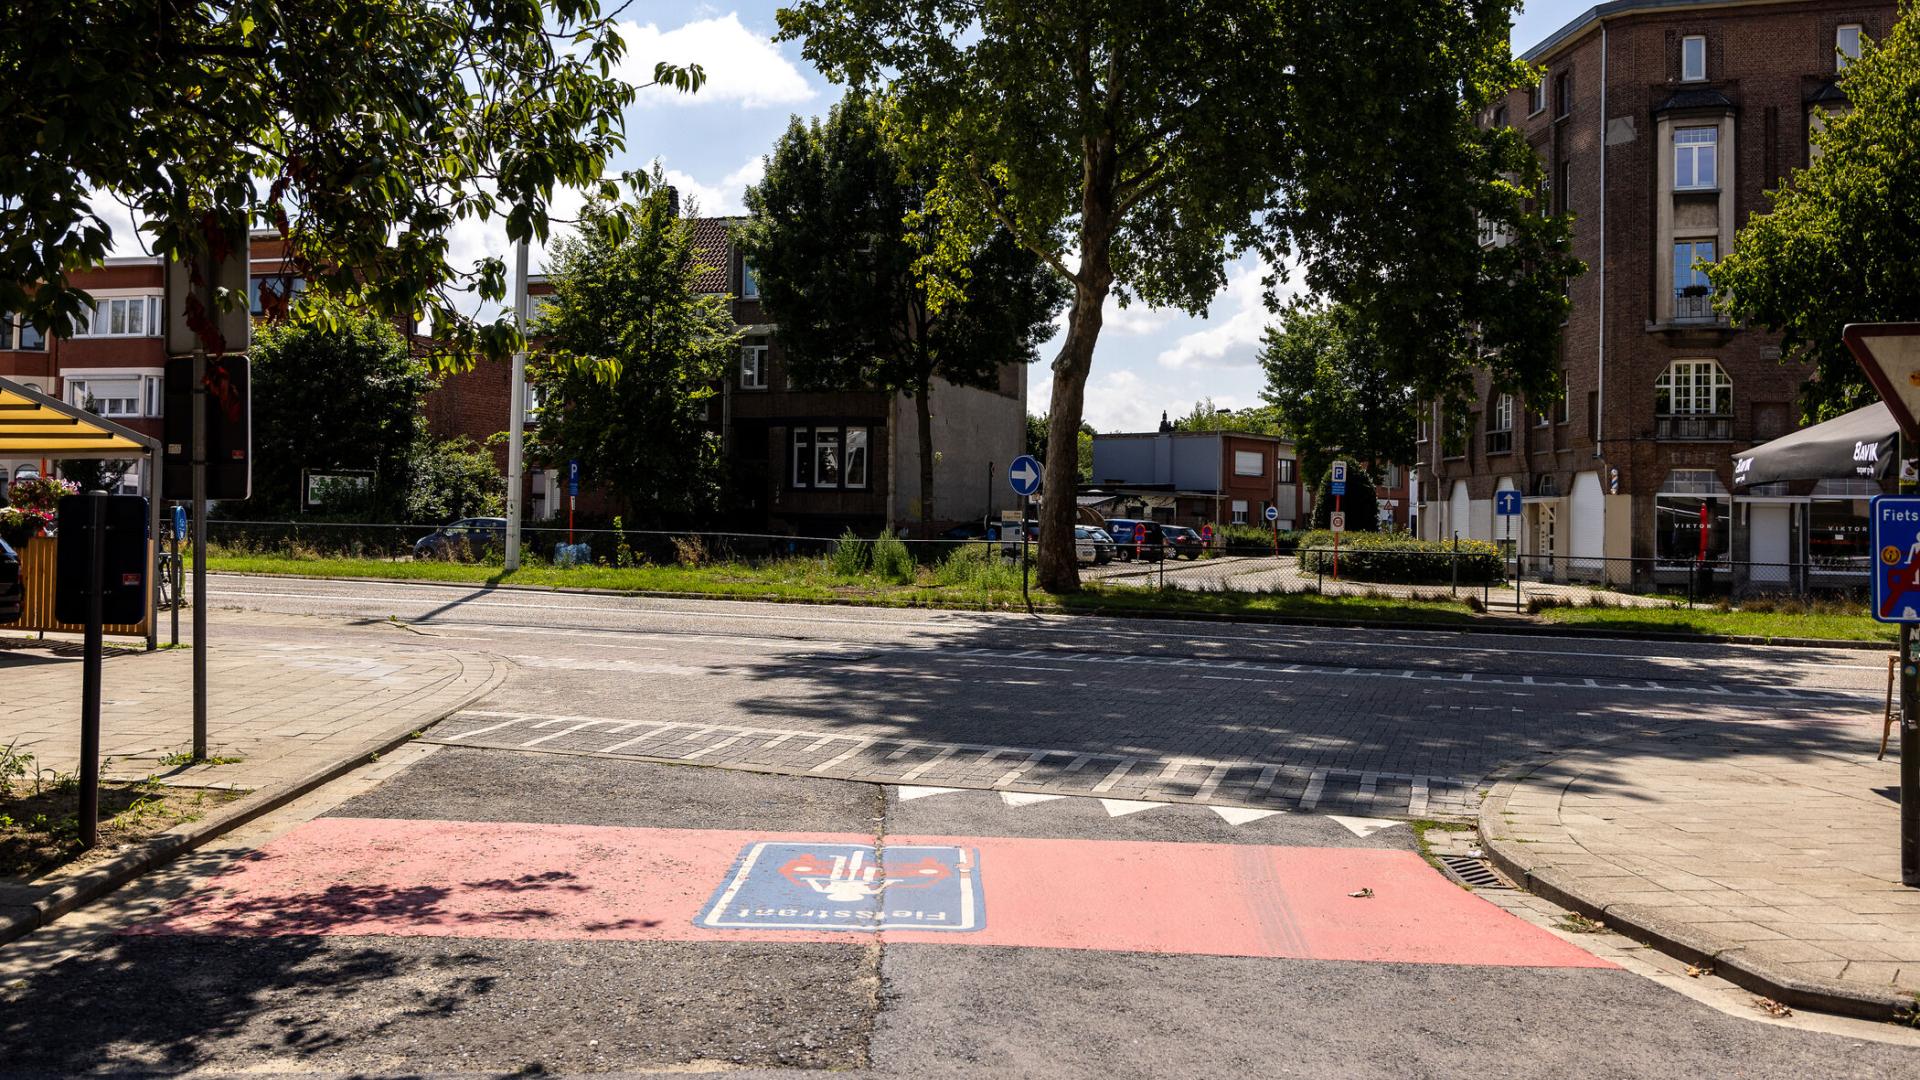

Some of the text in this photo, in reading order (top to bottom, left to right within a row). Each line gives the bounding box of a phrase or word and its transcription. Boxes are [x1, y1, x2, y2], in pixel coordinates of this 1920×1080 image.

[571, 463, 578, 479] P
[1335, 468, 1343, 478] P
[1883, 508, 1919, 521] Fiets
